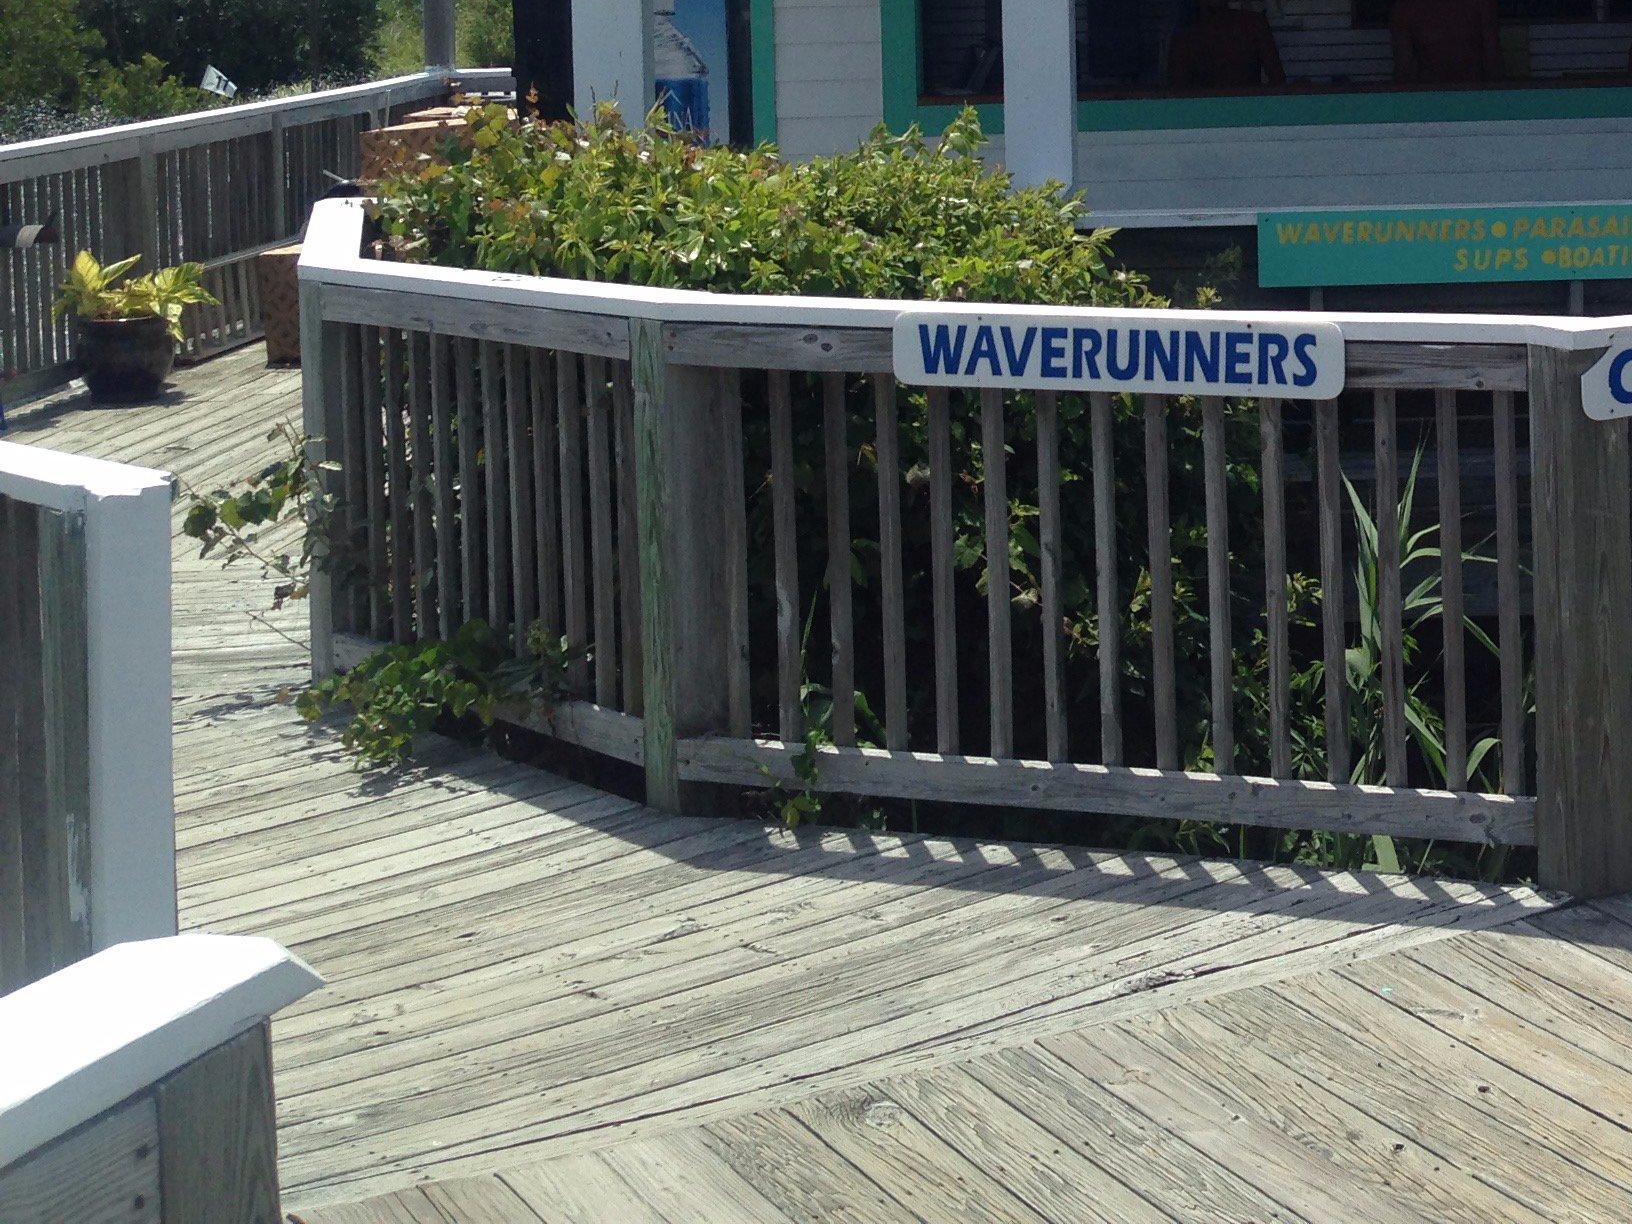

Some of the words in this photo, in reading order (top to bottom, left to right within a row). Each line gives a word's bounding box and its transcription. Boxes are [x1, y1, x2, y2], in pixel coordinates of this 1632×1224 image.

[1276, 219, 1486, 244] WAVERUNNERS
[1454, 247, 1528, 271] SUPS
[918, 324, 1319, 387] WAVERUNNERS
